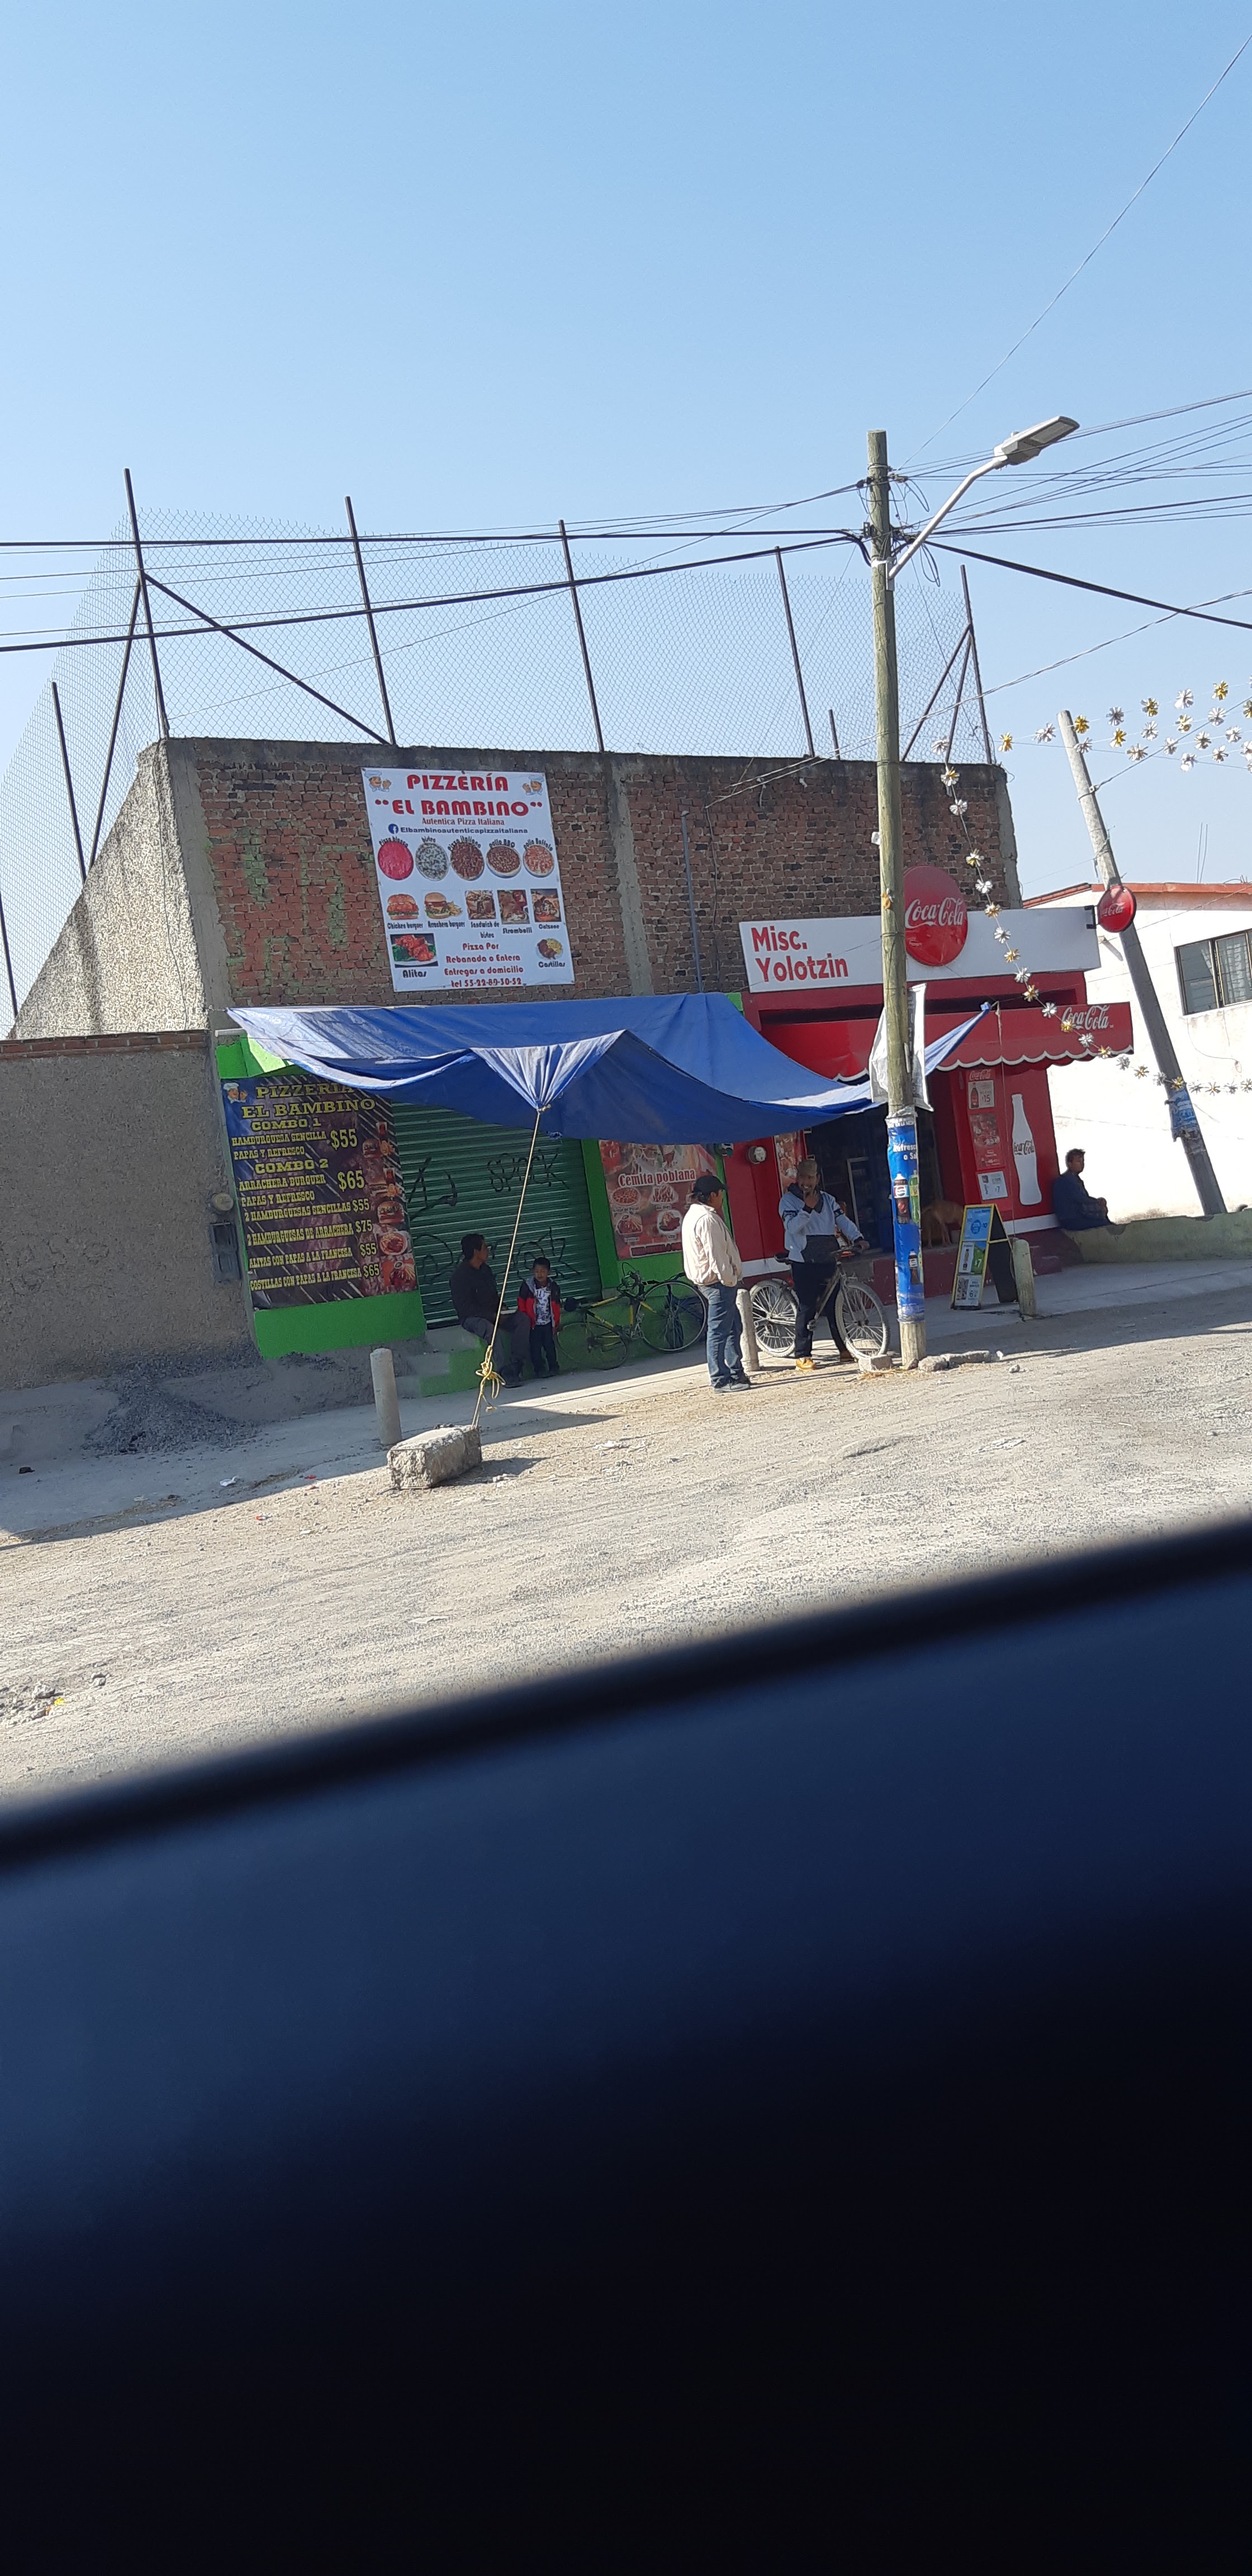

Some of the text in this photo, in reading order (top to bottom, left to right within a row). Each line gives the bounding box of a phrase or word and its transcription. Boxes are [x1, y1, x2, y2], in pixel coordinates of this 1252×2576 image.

[904, 897, 964, 929] Coca-Cola
[463, 942, 484, 950] Pizza
[751, 925, 807, 951] Misc.
[446, 955, 486, 964] Rebanada
[755, 953, 849, 982] Yolotzin
[402, 969, 427, 978] Alitas
[444, 968, 477, 977] Entregas
[1062, 1005, 1110, 1030] Coca-Cola
[241, 1099, 375, 1118] EL BAMBINO
[252, 1118, 321, 1131] COMBO 1
[231, 1128, 358, 1150] HAMBURGUESA SENCILLA $55
[234, 1146, 305, 1160] PAPAS Y REFRESCO
[255, 1159, 329, 1174] COMBO 2
[239, 1170, 364, 1191] ARRACHERA BURGUER $65
[619, 1169, 695, 1186] Cemita poblana
[241, 1191, 315, 1207] PAPAS Y REFRESCO
[245, 1198, 369, 1221] 2 HAMBURGUESAS SENCILLAS $55
[247, 1219, 372, 1246] 2 HAMBURGUESAS DE ARRACHERA $75
[249, 1243, 376, 1268] ALITAS CON PAPAS A LA FRANCESA $55
[250, 1264, 380, 1291] COSTILLAS CON PAPAS A LA FRANCESA $65
